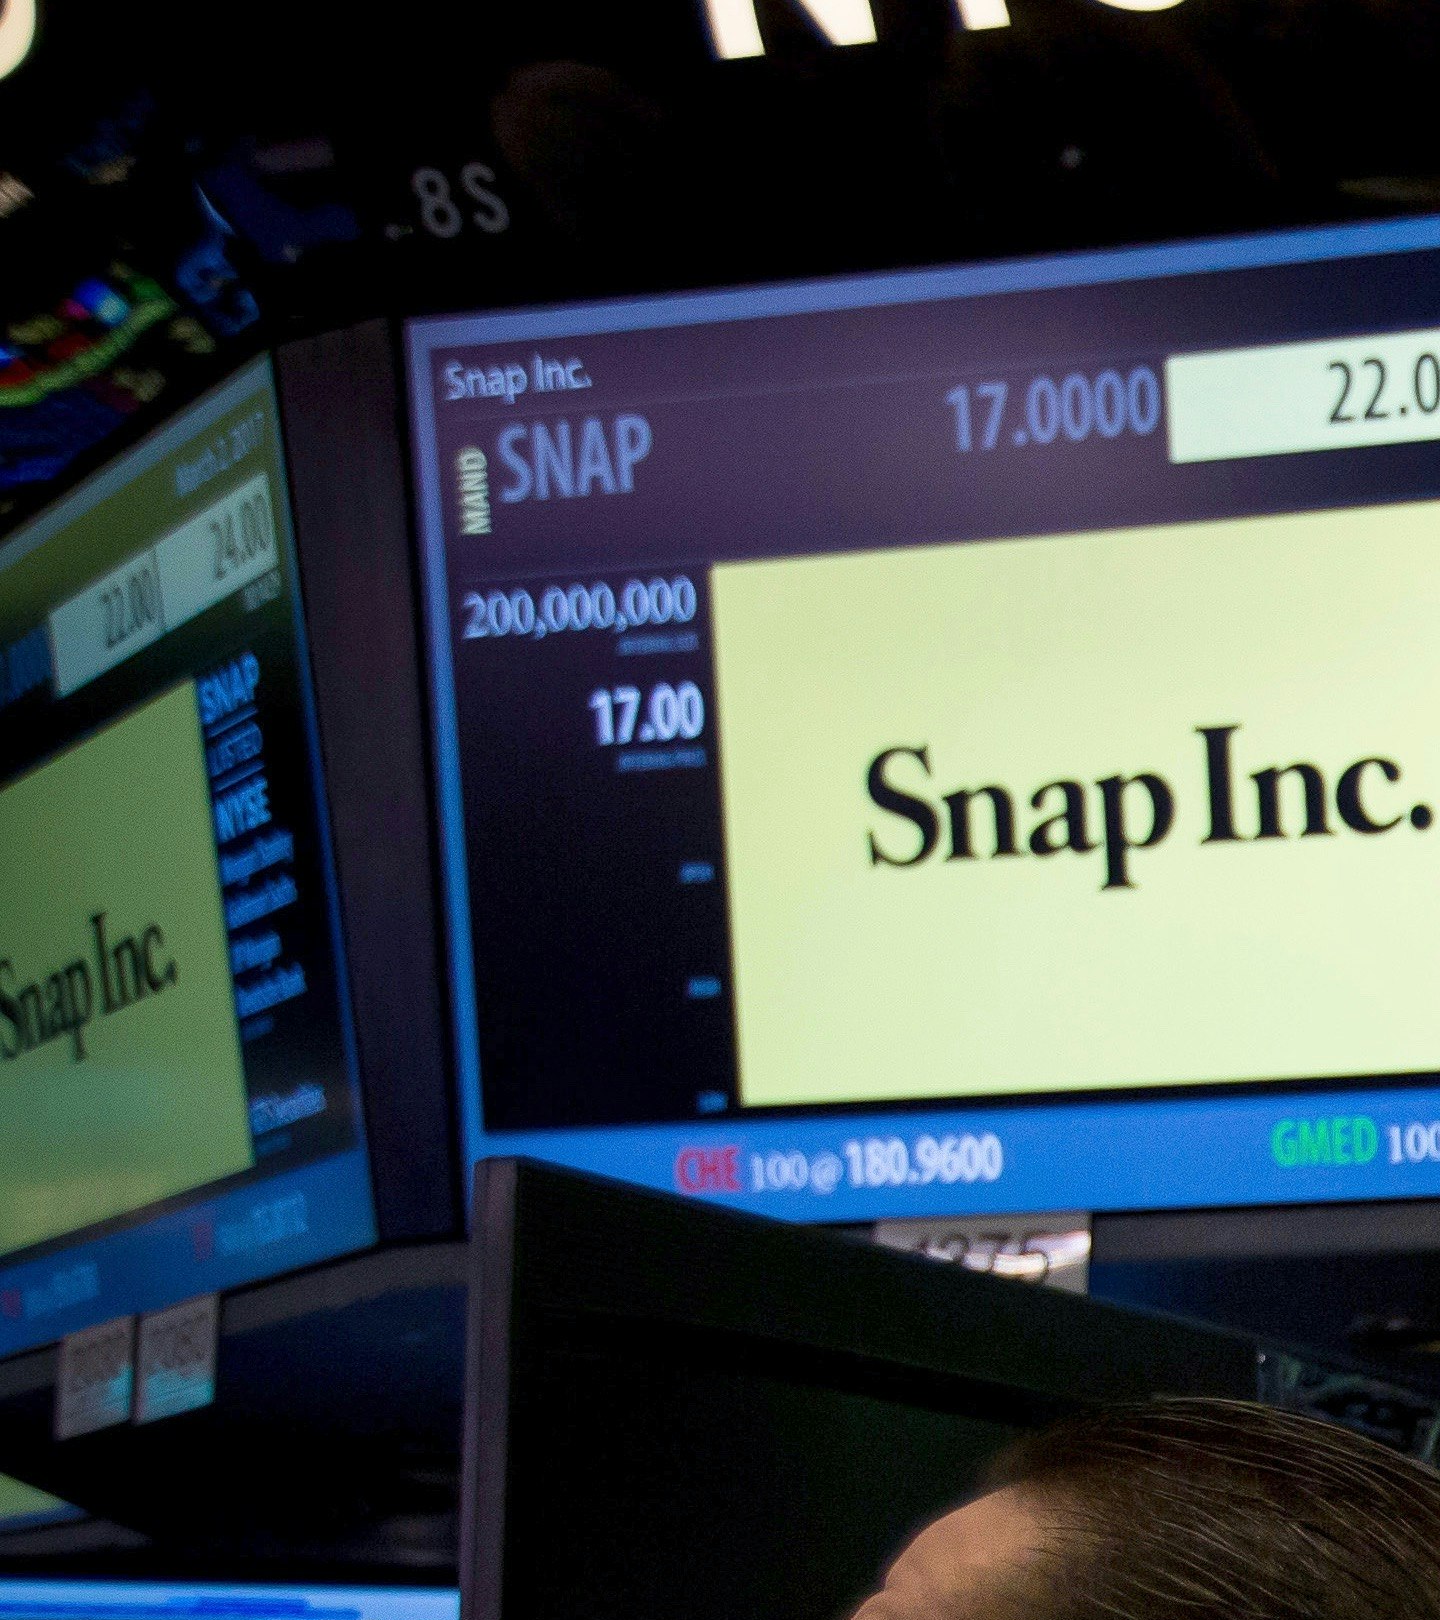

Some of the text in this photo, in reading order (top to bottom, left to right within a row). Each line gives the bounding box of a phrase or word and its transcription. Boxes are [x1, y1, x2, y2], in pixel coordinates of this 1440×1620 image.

[412, 162, 510, 238] 8S
[445, 354, 592, 403] Snap Inc.
[946, 366, 1161, 453] 17.0000
[499, 413, 654, 504] SNAP
[462, 575, 699, 641] 200,000,000
[588, 680, 706, 747] 17.00
[864, 724, 1437, 892] Snap Inc.
[91, 912, 178, 1013] Inc.
[1269, 1116, 1378, 1168] GMED
